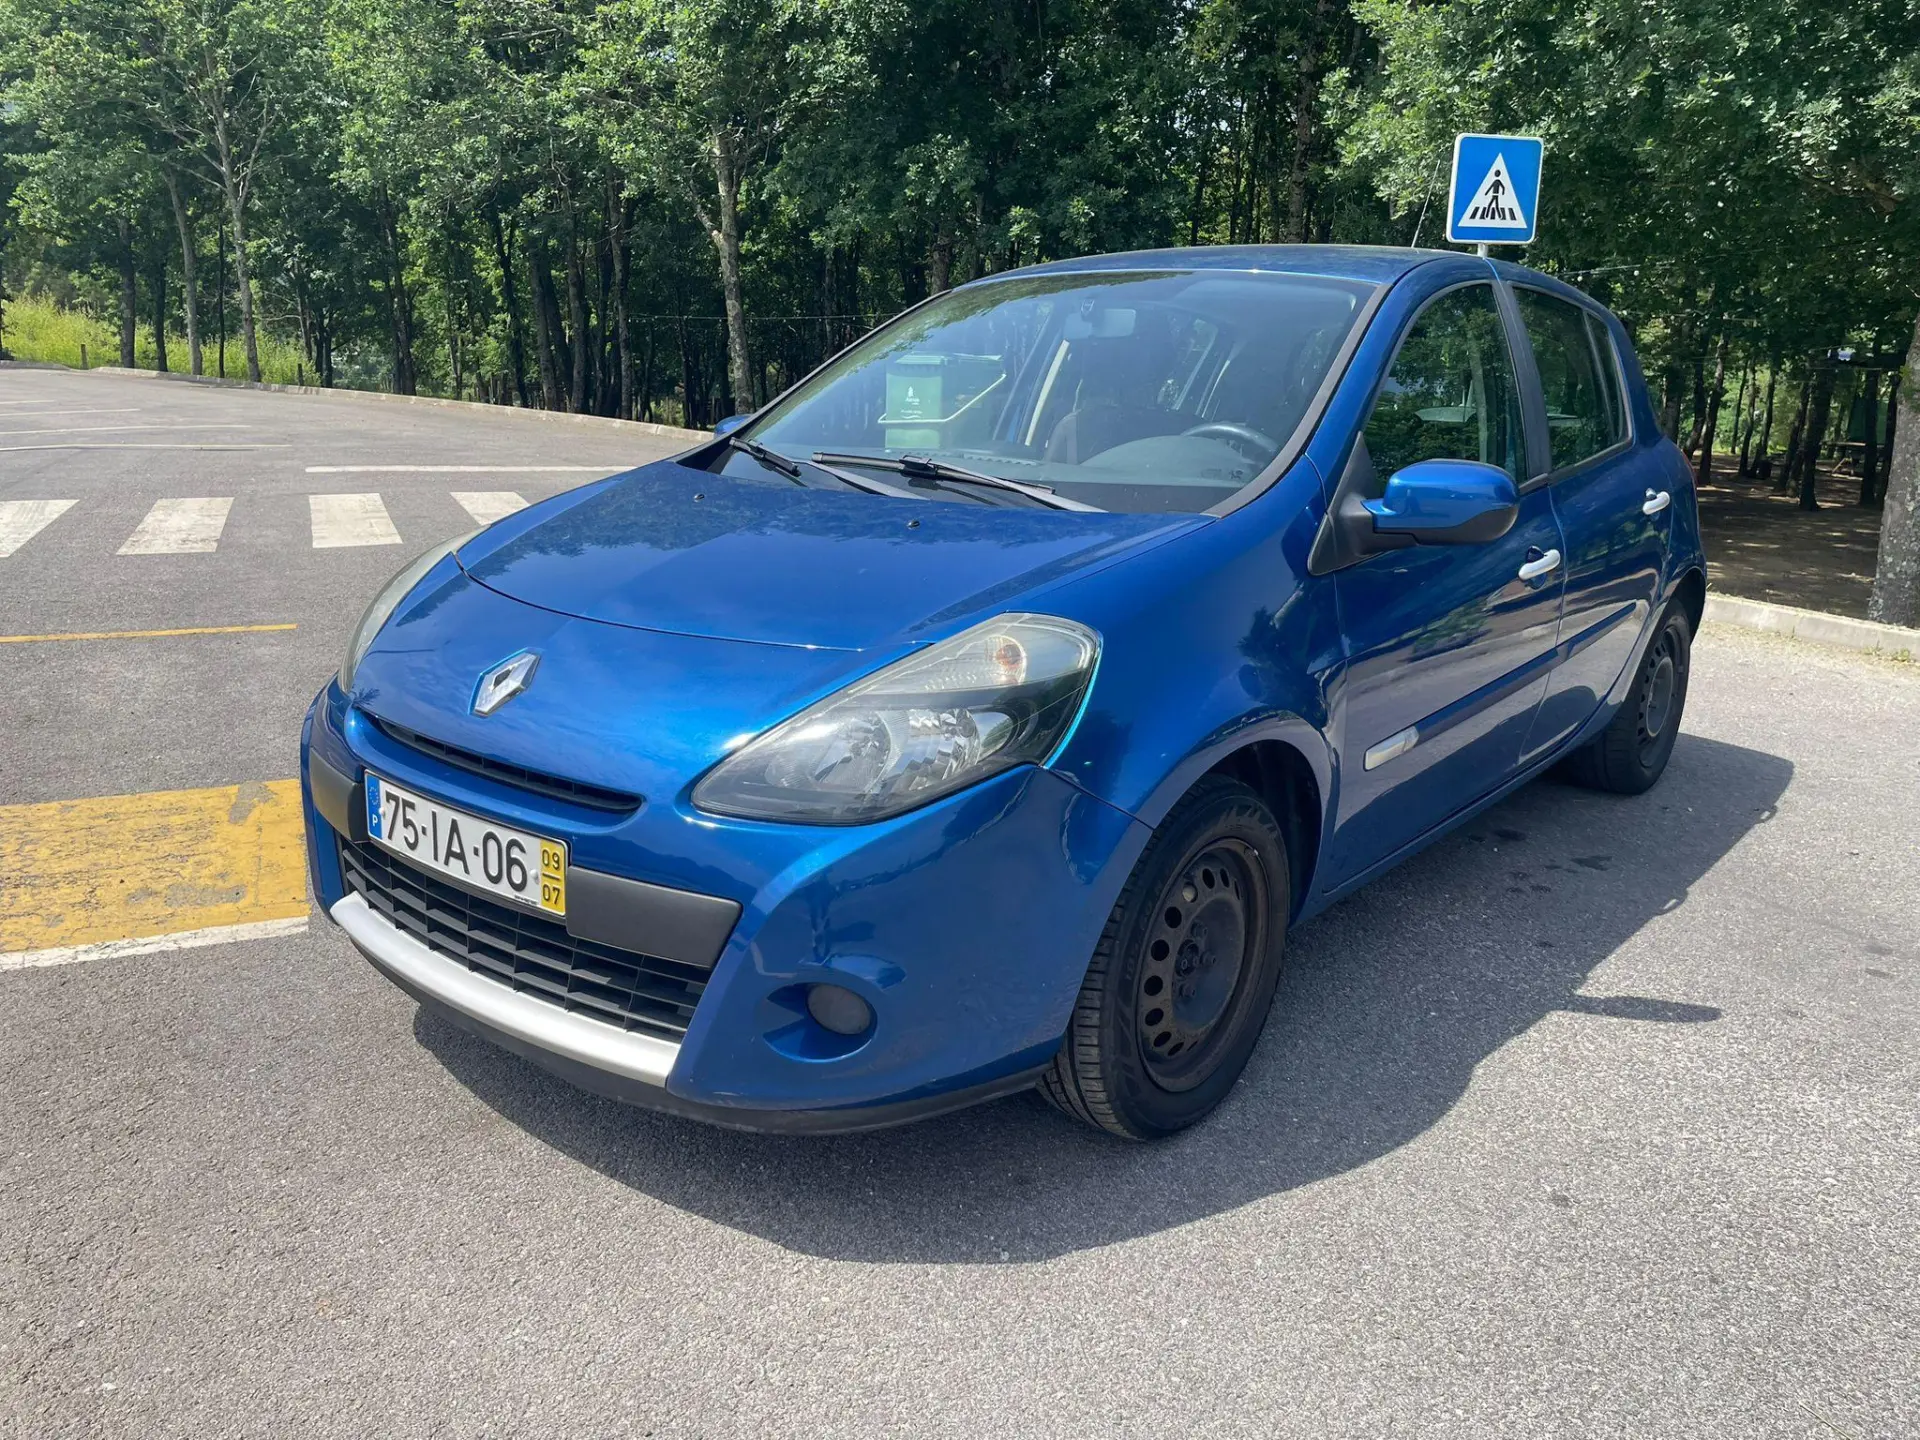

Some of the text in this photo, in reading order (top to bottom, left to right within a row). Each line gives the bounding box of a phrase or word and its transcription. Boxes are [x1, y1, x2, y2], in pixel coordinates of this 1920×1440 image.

[372, 814, 379, 826] P
[541, 849, 560, 870] 09
[542, 885, 560, 905] 07
